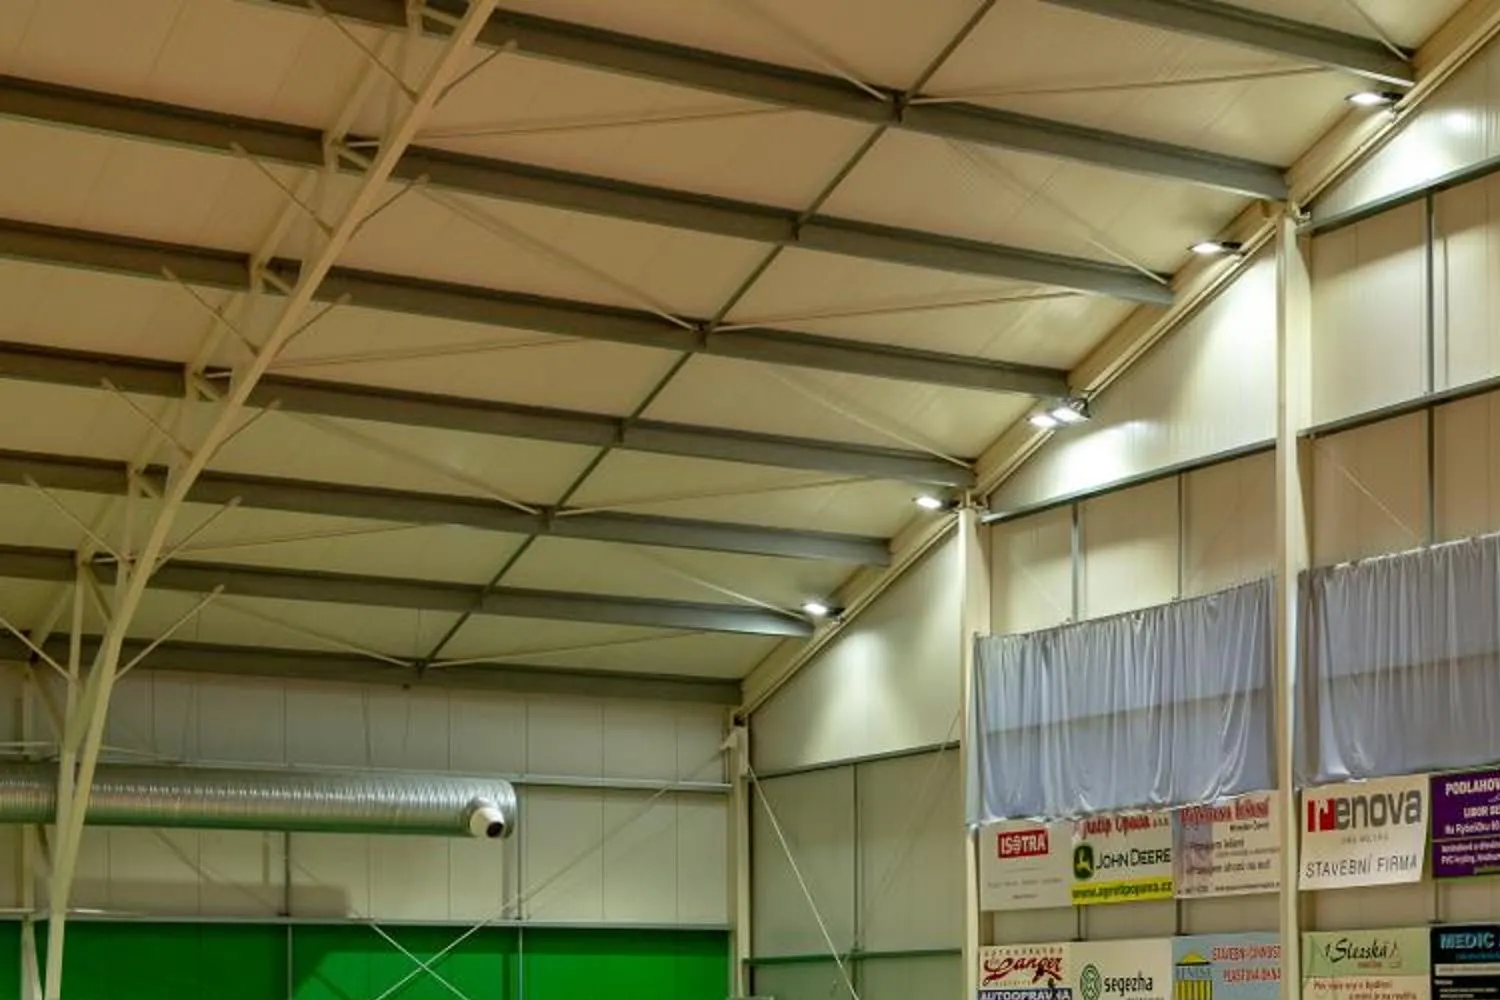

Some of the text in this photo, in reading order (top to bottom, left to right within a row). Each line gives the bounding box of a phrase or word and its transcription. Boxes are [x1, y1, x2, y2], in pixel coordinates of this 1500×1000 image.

[1096, 852, 1129, 870] JOHN
[1130, 848, 1171, 867] DEERE
[1305, 854, 1418, 880] STAVEBNÍ FIRMA
[1439, 932, 1495, 949] MEDIC
[1104, 971, 1154, 997] segezha
